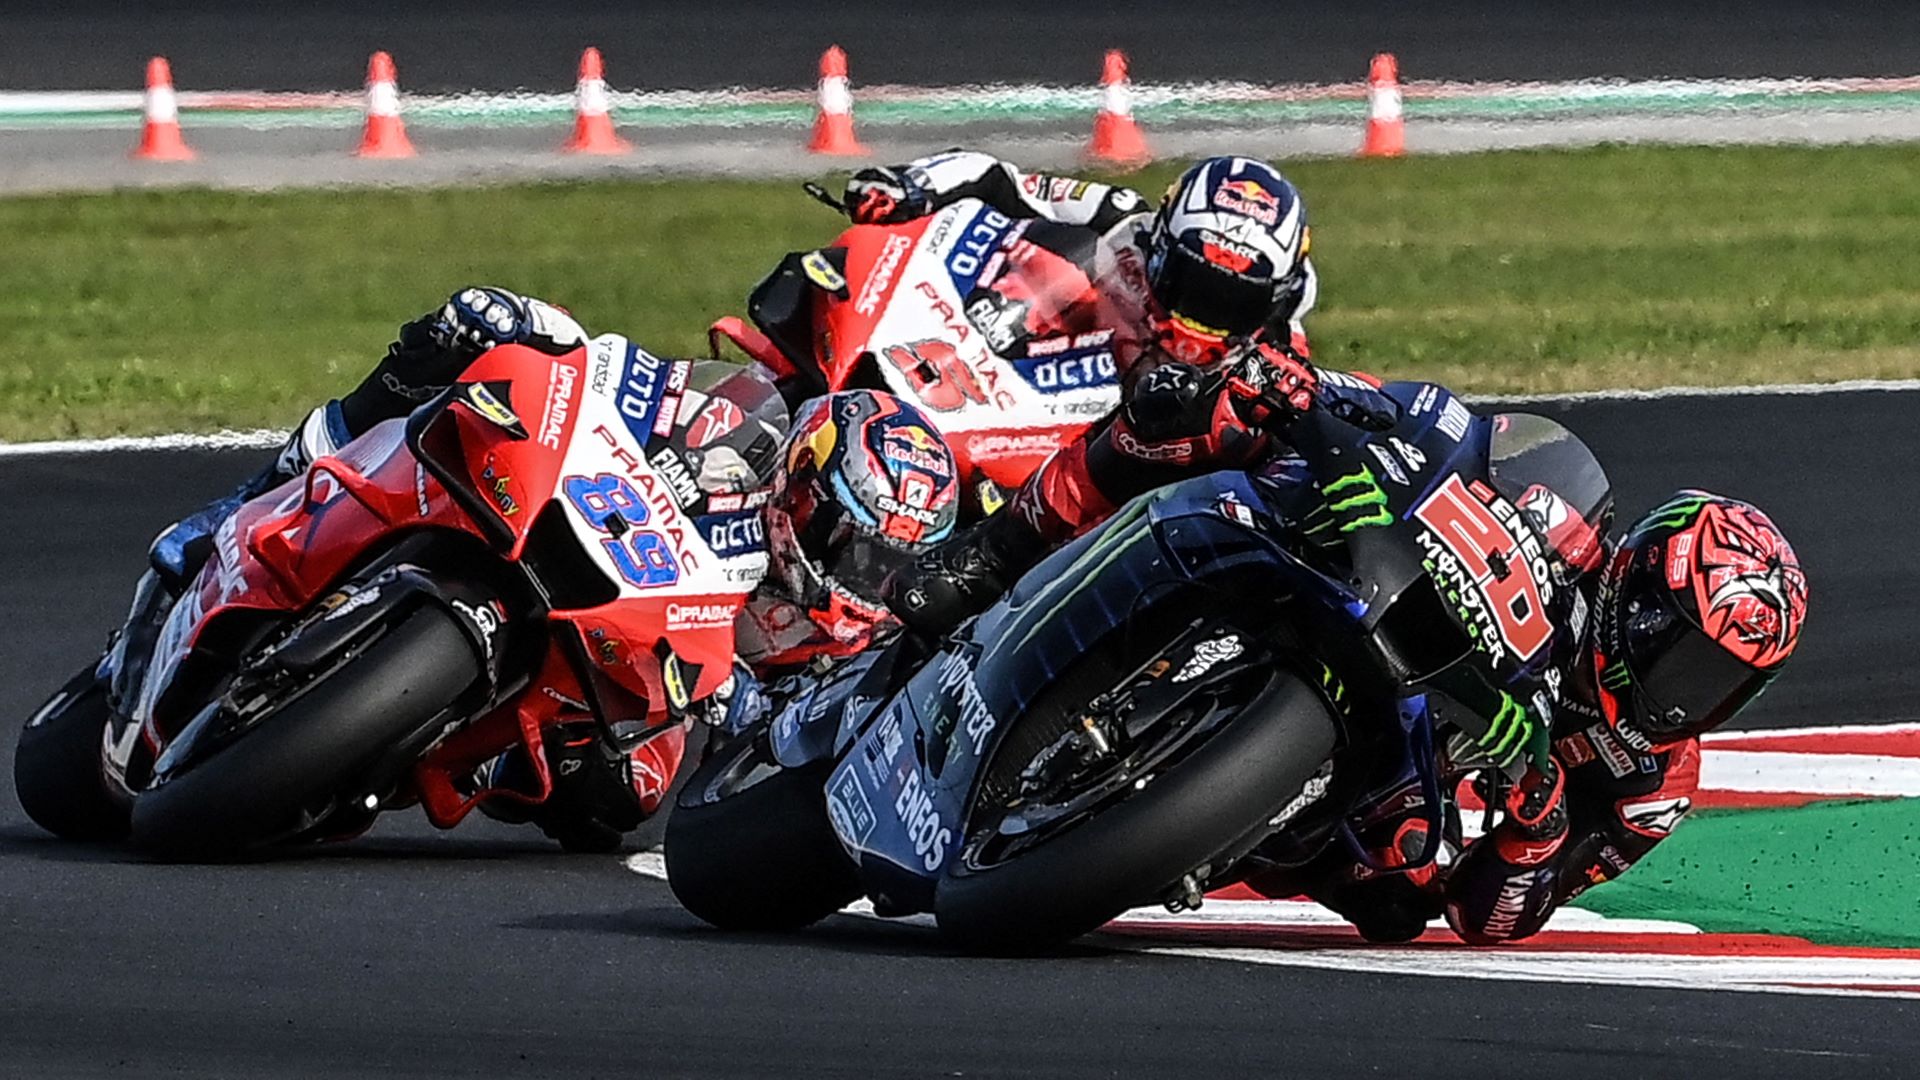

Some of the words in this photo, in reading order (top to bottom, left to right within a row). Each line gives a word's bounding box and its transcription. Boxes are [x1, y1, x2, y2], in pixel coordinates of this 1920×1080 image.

[951, 213, 1011, 277] OCTO
[621, 348, 660, 420] OCTO
[1036, 353, 1116, 385] OCTO
[551, 377, 573, 450] PRAMAC
[650, 447, 701, 509] FIAMM
[884, 441, 917, 464] Red
[562, 473, 680, 590] 89
[592, 424, 699, 577] PRAMAC
[876, 496, 939, 526] SHARK
[1414, 473, 1554, 661] 20
[1490, 497, 1552, 606] ENEOS
[1415, 531, 1506, 669] MONSTER
[896, 770, 950, 871] ENEOS
